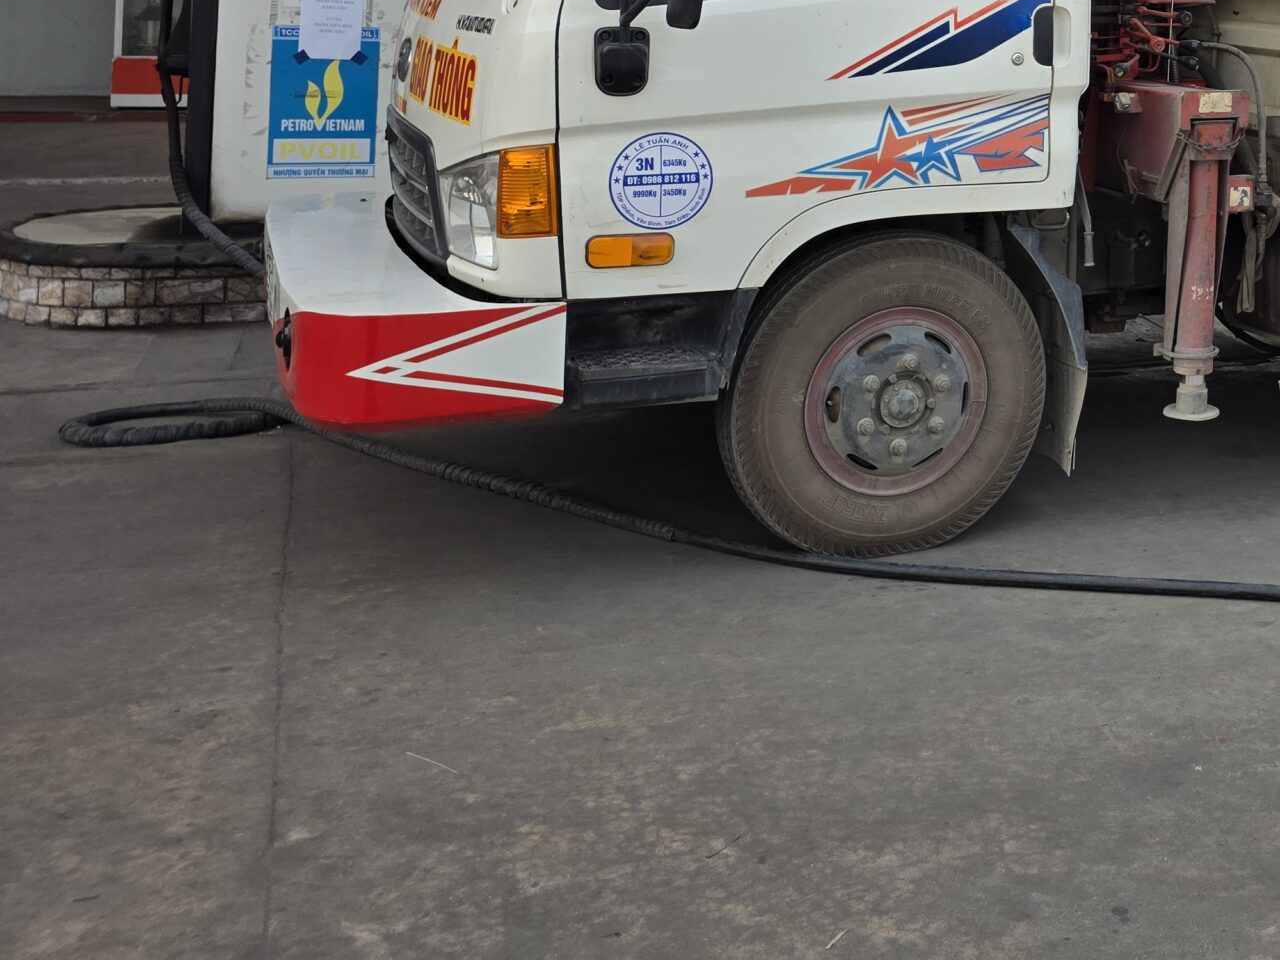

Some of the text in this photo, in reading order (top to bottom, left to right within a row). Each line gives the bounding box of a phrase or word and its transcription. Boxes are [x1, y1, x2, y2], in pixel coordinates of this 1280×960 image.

[456, 14, 497, 35] HYUNDAI
[428, 36, 478, 125] THÔNG
[281, 119, 365, 133] PETROVIETNAM
[647, 136, 670, 146] TUẤN
[672, 140, 689, 150] ANH
[280, 141, 362, 161] PVOIL
[635, 157, 654, 171] 3N
[627, 174, 696, 185] ĐT: 0988 812 116
